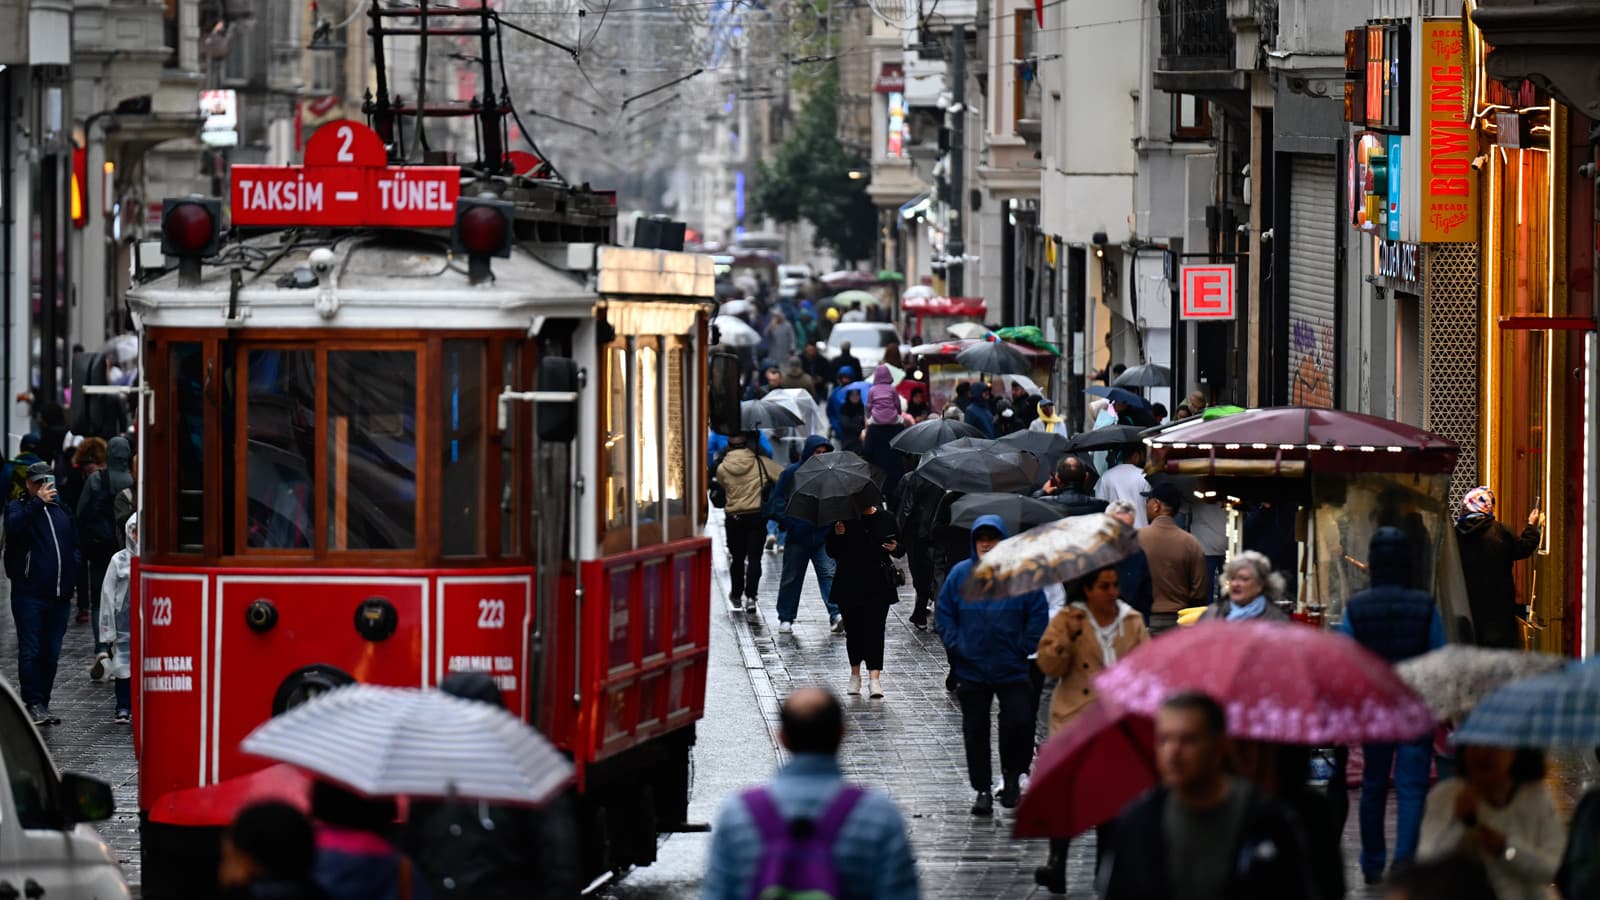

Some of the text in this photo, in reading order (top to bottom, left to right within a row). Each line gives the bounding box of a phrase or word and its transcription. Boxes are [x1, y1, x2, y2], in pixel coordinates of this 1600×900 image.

[1432, 30, 1462, 38] ARCAD
[1431, 40, 1462, 60] Tiger
[336, 125, 354, 162] 2
[1431, 66, 1470, 196] BOWLING
[239, 173, 324, 211] TAKSİM
[378, 172, 453, 210] TÜNEL
[1431, 203, 1468, 211] ARCADE
[1430, 212, 1469, 234] Tigers
[1193, 275, 1222, 308] E
[152, 597, 172, 626] 223
[477, 598, 505, 629] 223
[163, 656, 193, 671] YASAK
